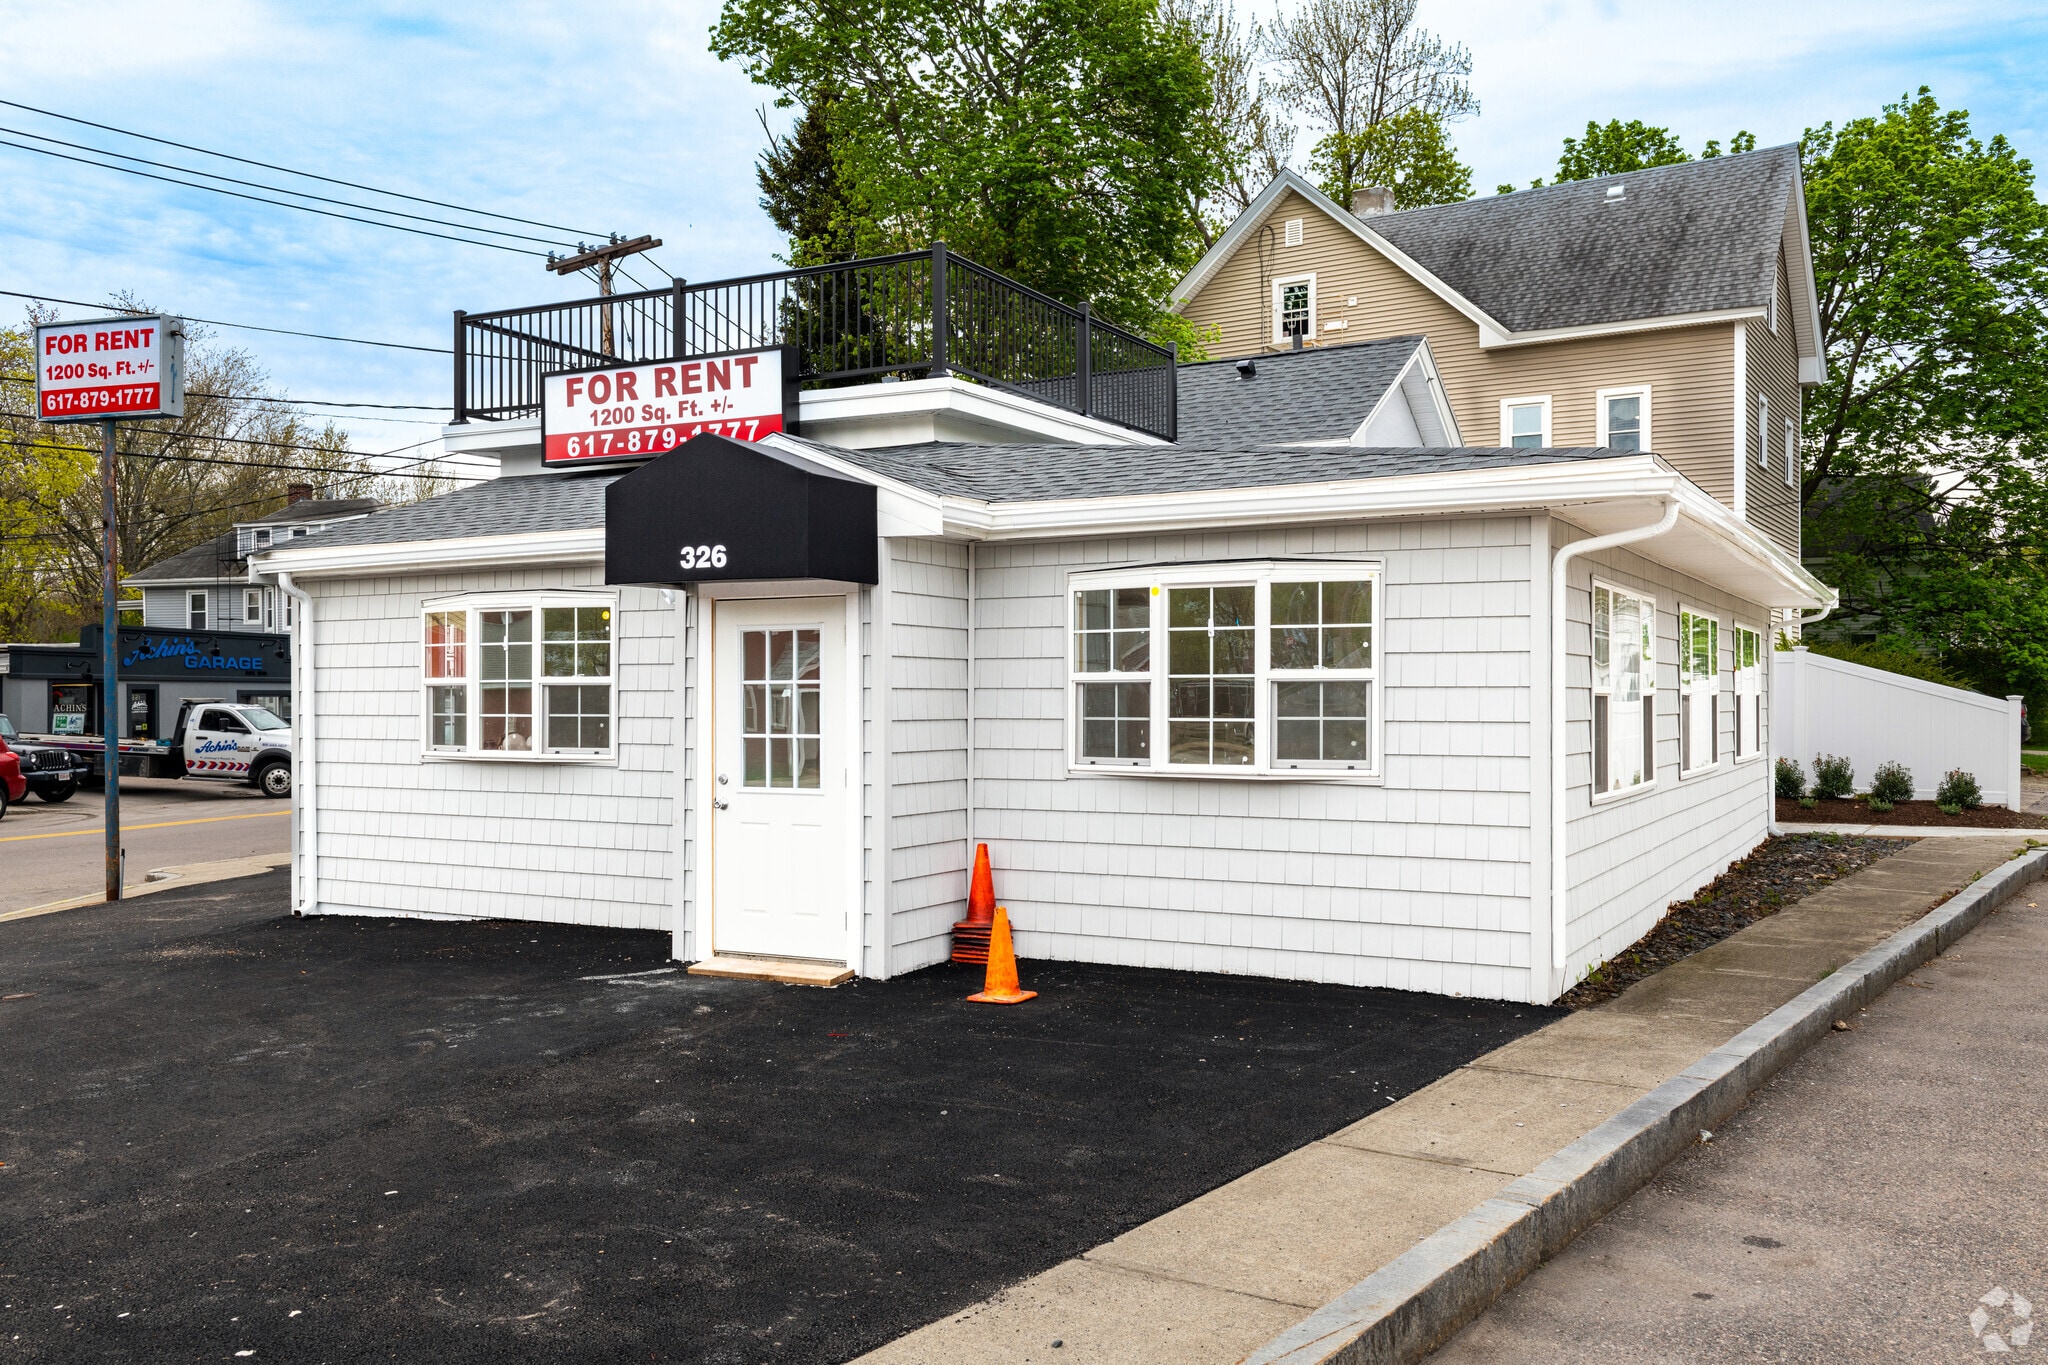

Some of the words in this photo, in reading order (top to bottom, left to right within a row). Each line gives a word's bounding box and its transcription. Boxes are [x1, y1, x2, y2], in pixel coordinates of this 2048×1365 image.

[46, 334, 88, 355] FOR
[95, 328, 154, 351] RENT
[46, 364, 85, 381] 1200
[88, 362, 111, 380] Sq.
[116, 361, 136, 376] Ft.
[137, 359, 154, 374] +/-
[566, 371, 638, 407] FOR
[654, 356, 759, 398] RENT
[47, 387, 154, 410] 617-879-1777
[590, 406, 635, 427] 1200
[642, 404, 671, 424] Sq.
[678, 400, 703, 418] Ft.
[711, 395, 733, 414] +/-
[680, 545, 727, 569] 326
[123, 637, 202, 667] Achin's
[185, 656, 263, 670] GARAGE
[53, 703, 87, 712] ACHIN'S
[195, 739, 238, 753] Achin's
